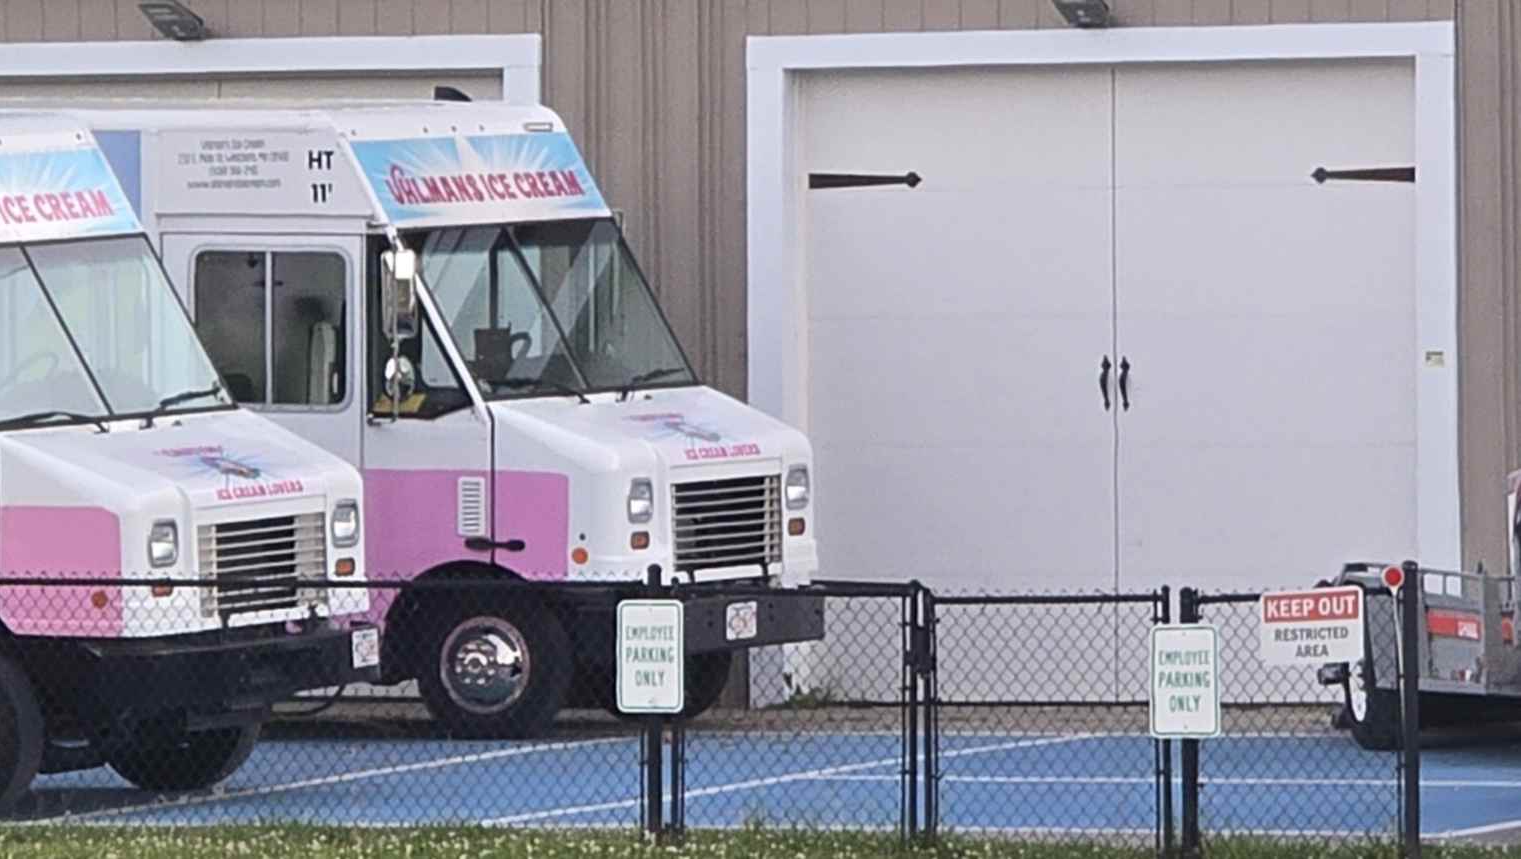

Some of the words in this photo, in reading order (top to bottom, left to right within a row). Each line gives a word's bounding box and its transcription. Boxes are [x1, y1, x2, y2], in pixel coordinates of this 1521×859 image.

[308, 150, 334, 170] HT
[385, 163, 486, 205] UHLMANS
[479, 173, 518, 200] ICE
[514, 169, 586, 198] CREAM
[32, 189, 115, 222] CREAM
[217, 489, 233, 500] ICE
[233, 485, 267, 499] CREAM
[268, 480, 304, 496] LOVERS
[1266, 601, 1314, 618] KEEP
[1317, 595, 1357, 615] OUT
[625, 625, 675, 641] EMPLOYEE
[1274, 626, 1349, 642] RESTRICTED
[625, 646, 675, 663] PARKING
[1159, 650, 1210, 665] EMPLOYEE
[1295, 644, 1330, 658] AREA
[635, 670, 665, 687] ONLY
[1159, 671, 1210, 688] PARKING
[1169, 695, 1201, 712] ONLY
